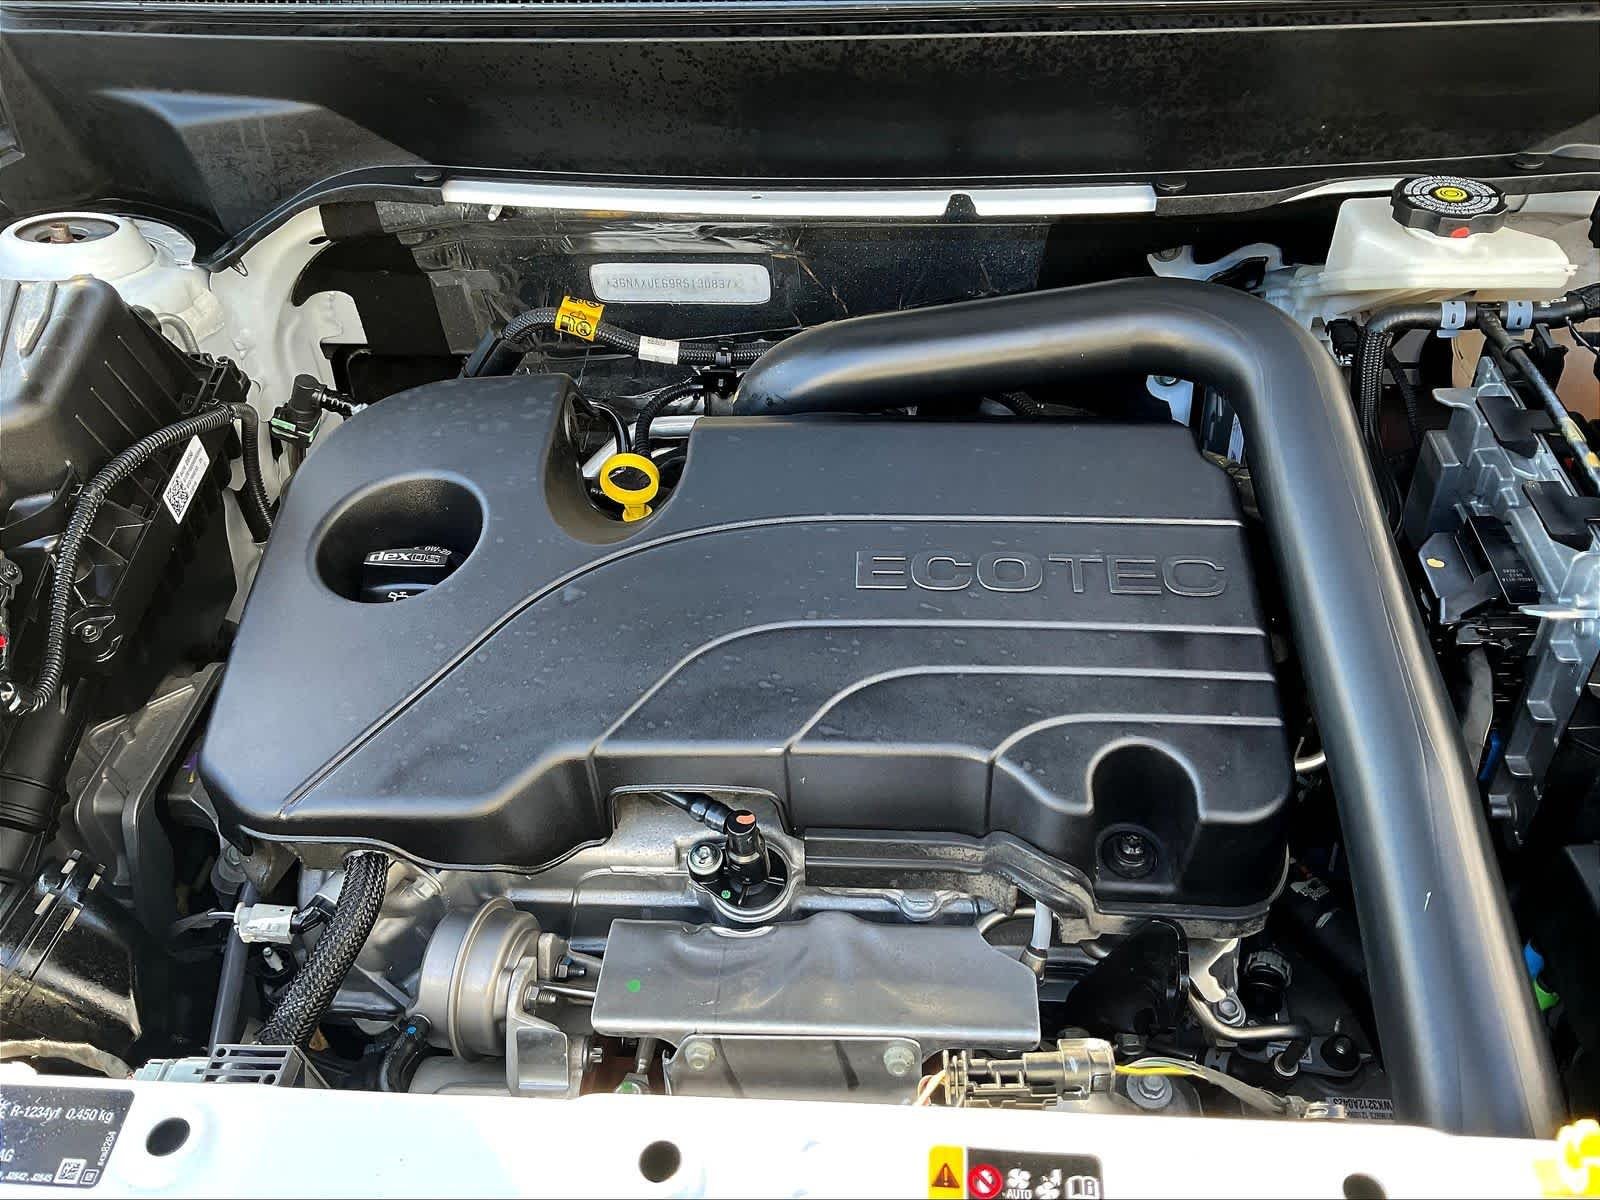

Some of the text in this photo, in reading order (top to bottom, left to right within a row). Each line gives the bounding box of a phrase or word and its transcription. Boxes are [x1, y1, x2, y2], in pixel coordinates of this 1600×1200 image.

[855, 551, 1226, 598] ECOTEC
[10, 1105, 62, 1121] R-1234yf
[98, 1108, 114, 1124] kg
[1006, 1188, 1033, 1200] AUTO
